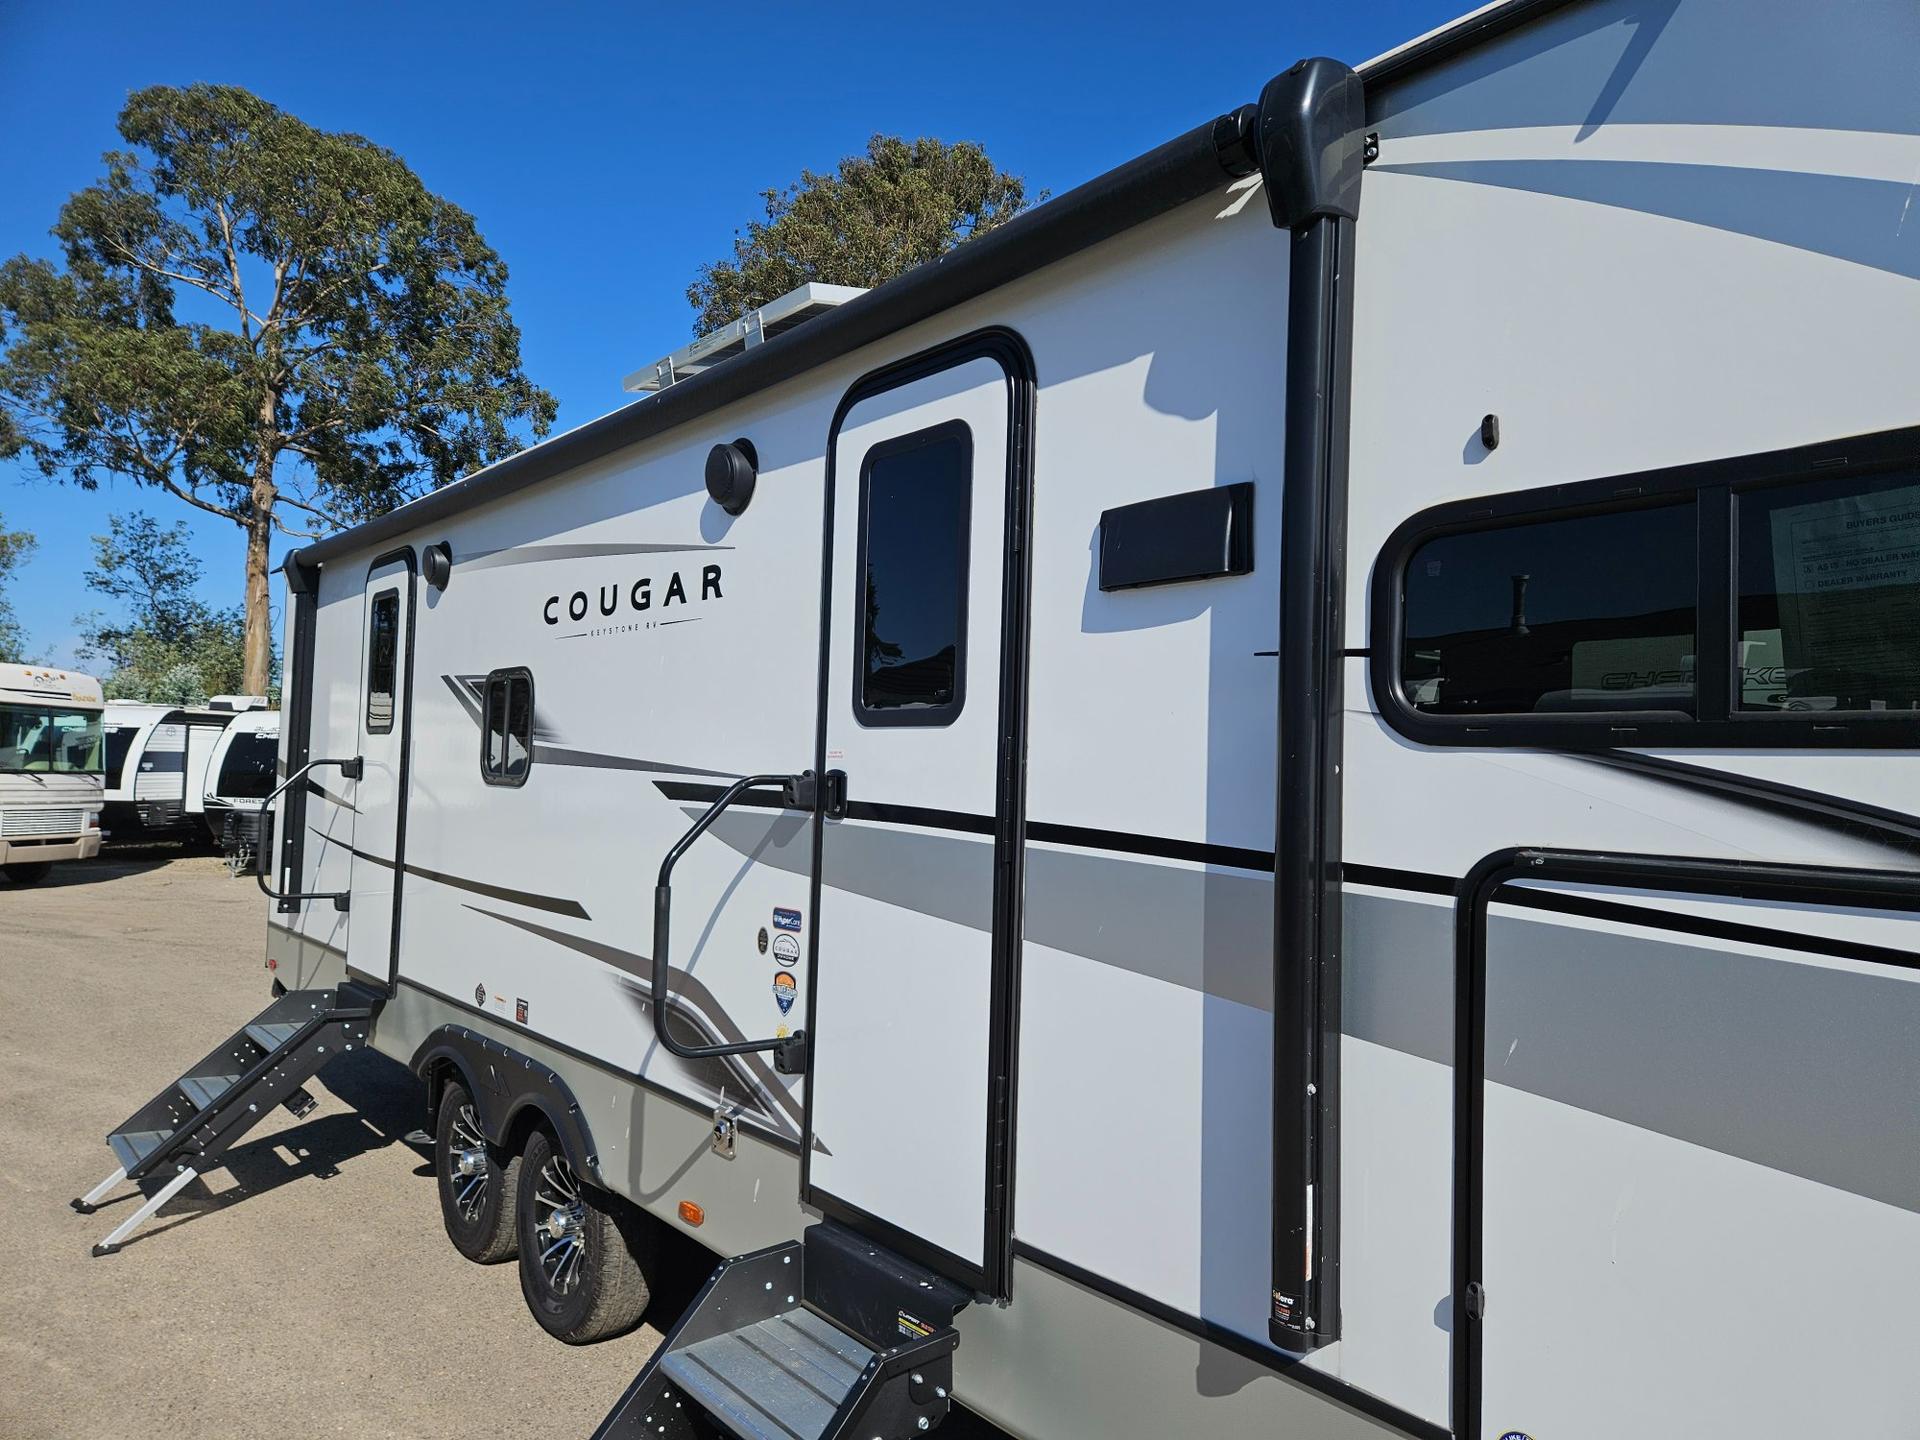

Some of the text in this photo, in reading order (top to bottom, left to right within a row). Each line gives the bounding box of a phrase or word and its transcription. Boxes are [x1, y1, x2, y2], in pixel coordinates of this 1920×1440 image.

[1846, 516, 1886, 529] BUYERS
[1846, 558, 1859, 567] NO
[1861, 553, 1898, 565] DEALER
[1817, 570, 1907, 588] DEALER WARRANTY
[543, 564, 723, 626] COUGAR
[590, 620, 658, 637] KEYSTONE RV
